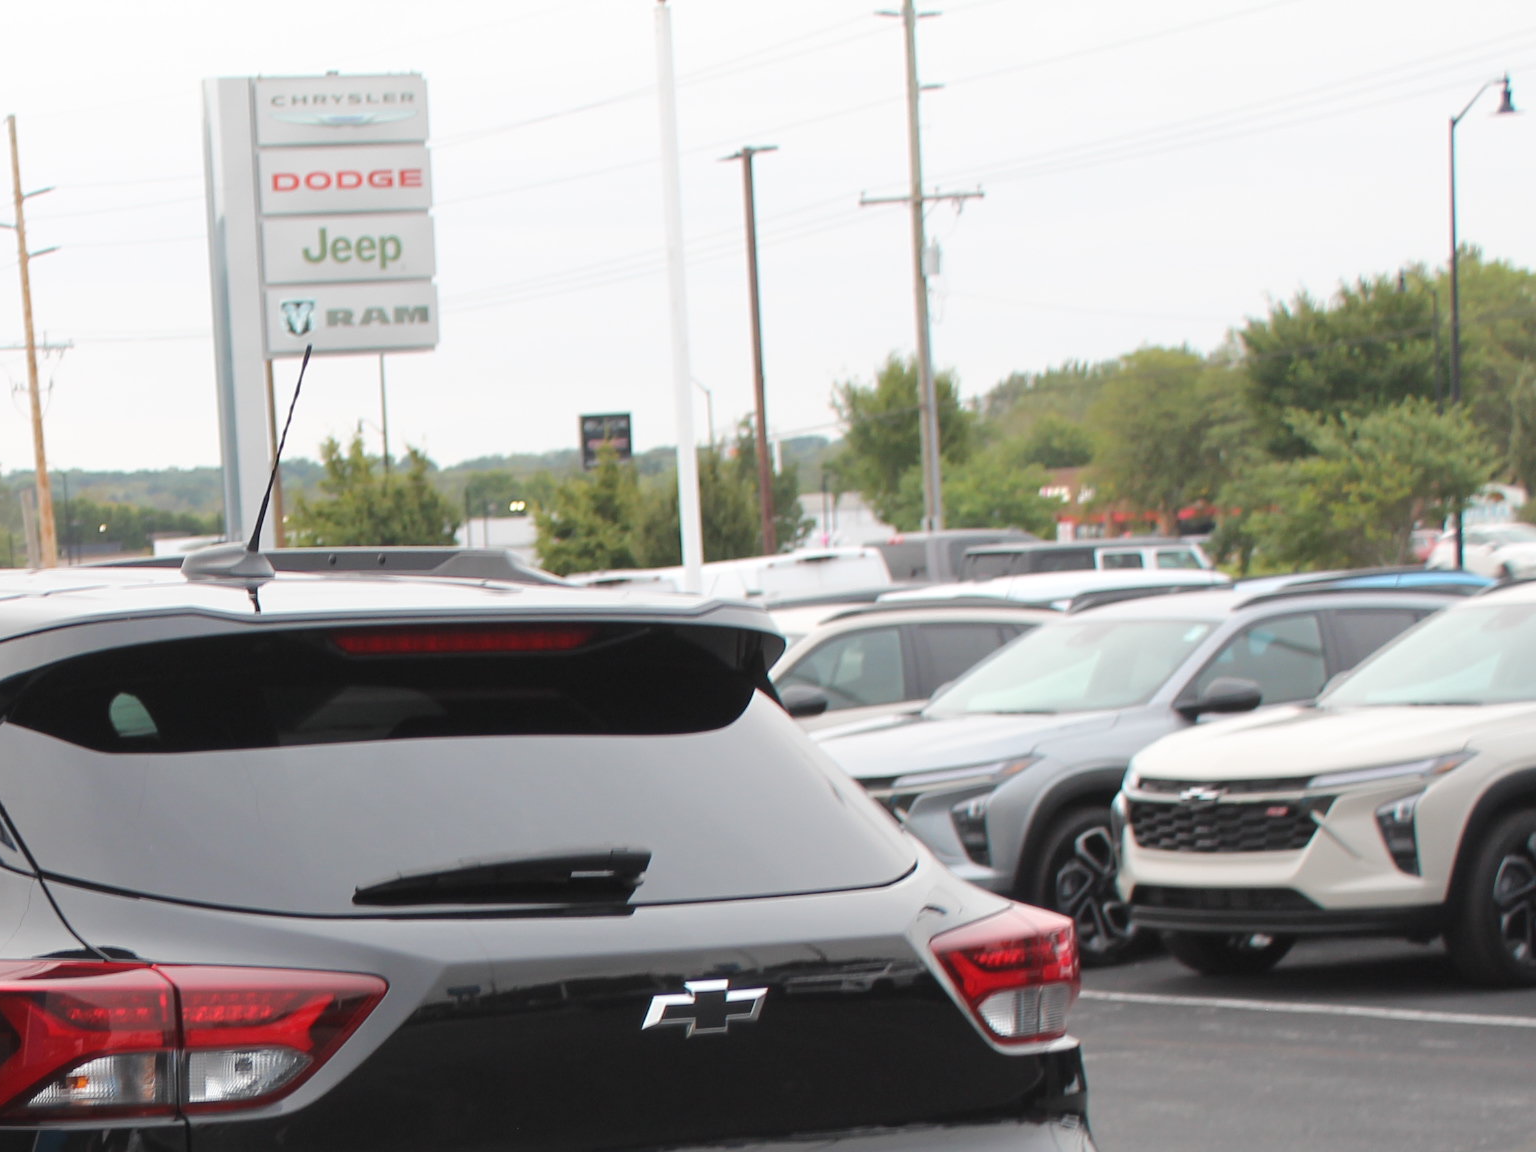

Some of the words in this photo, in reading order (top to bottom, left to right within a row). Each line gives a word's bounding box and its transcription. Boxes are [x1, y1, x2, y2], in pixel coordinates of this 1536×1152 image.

[270, 92, 415, 107] CHRYSLER
[272, 169, 423, 192] DODGE
[302, 227, 402, 270] Jeep
[325, 306, 430, 327] RAM
